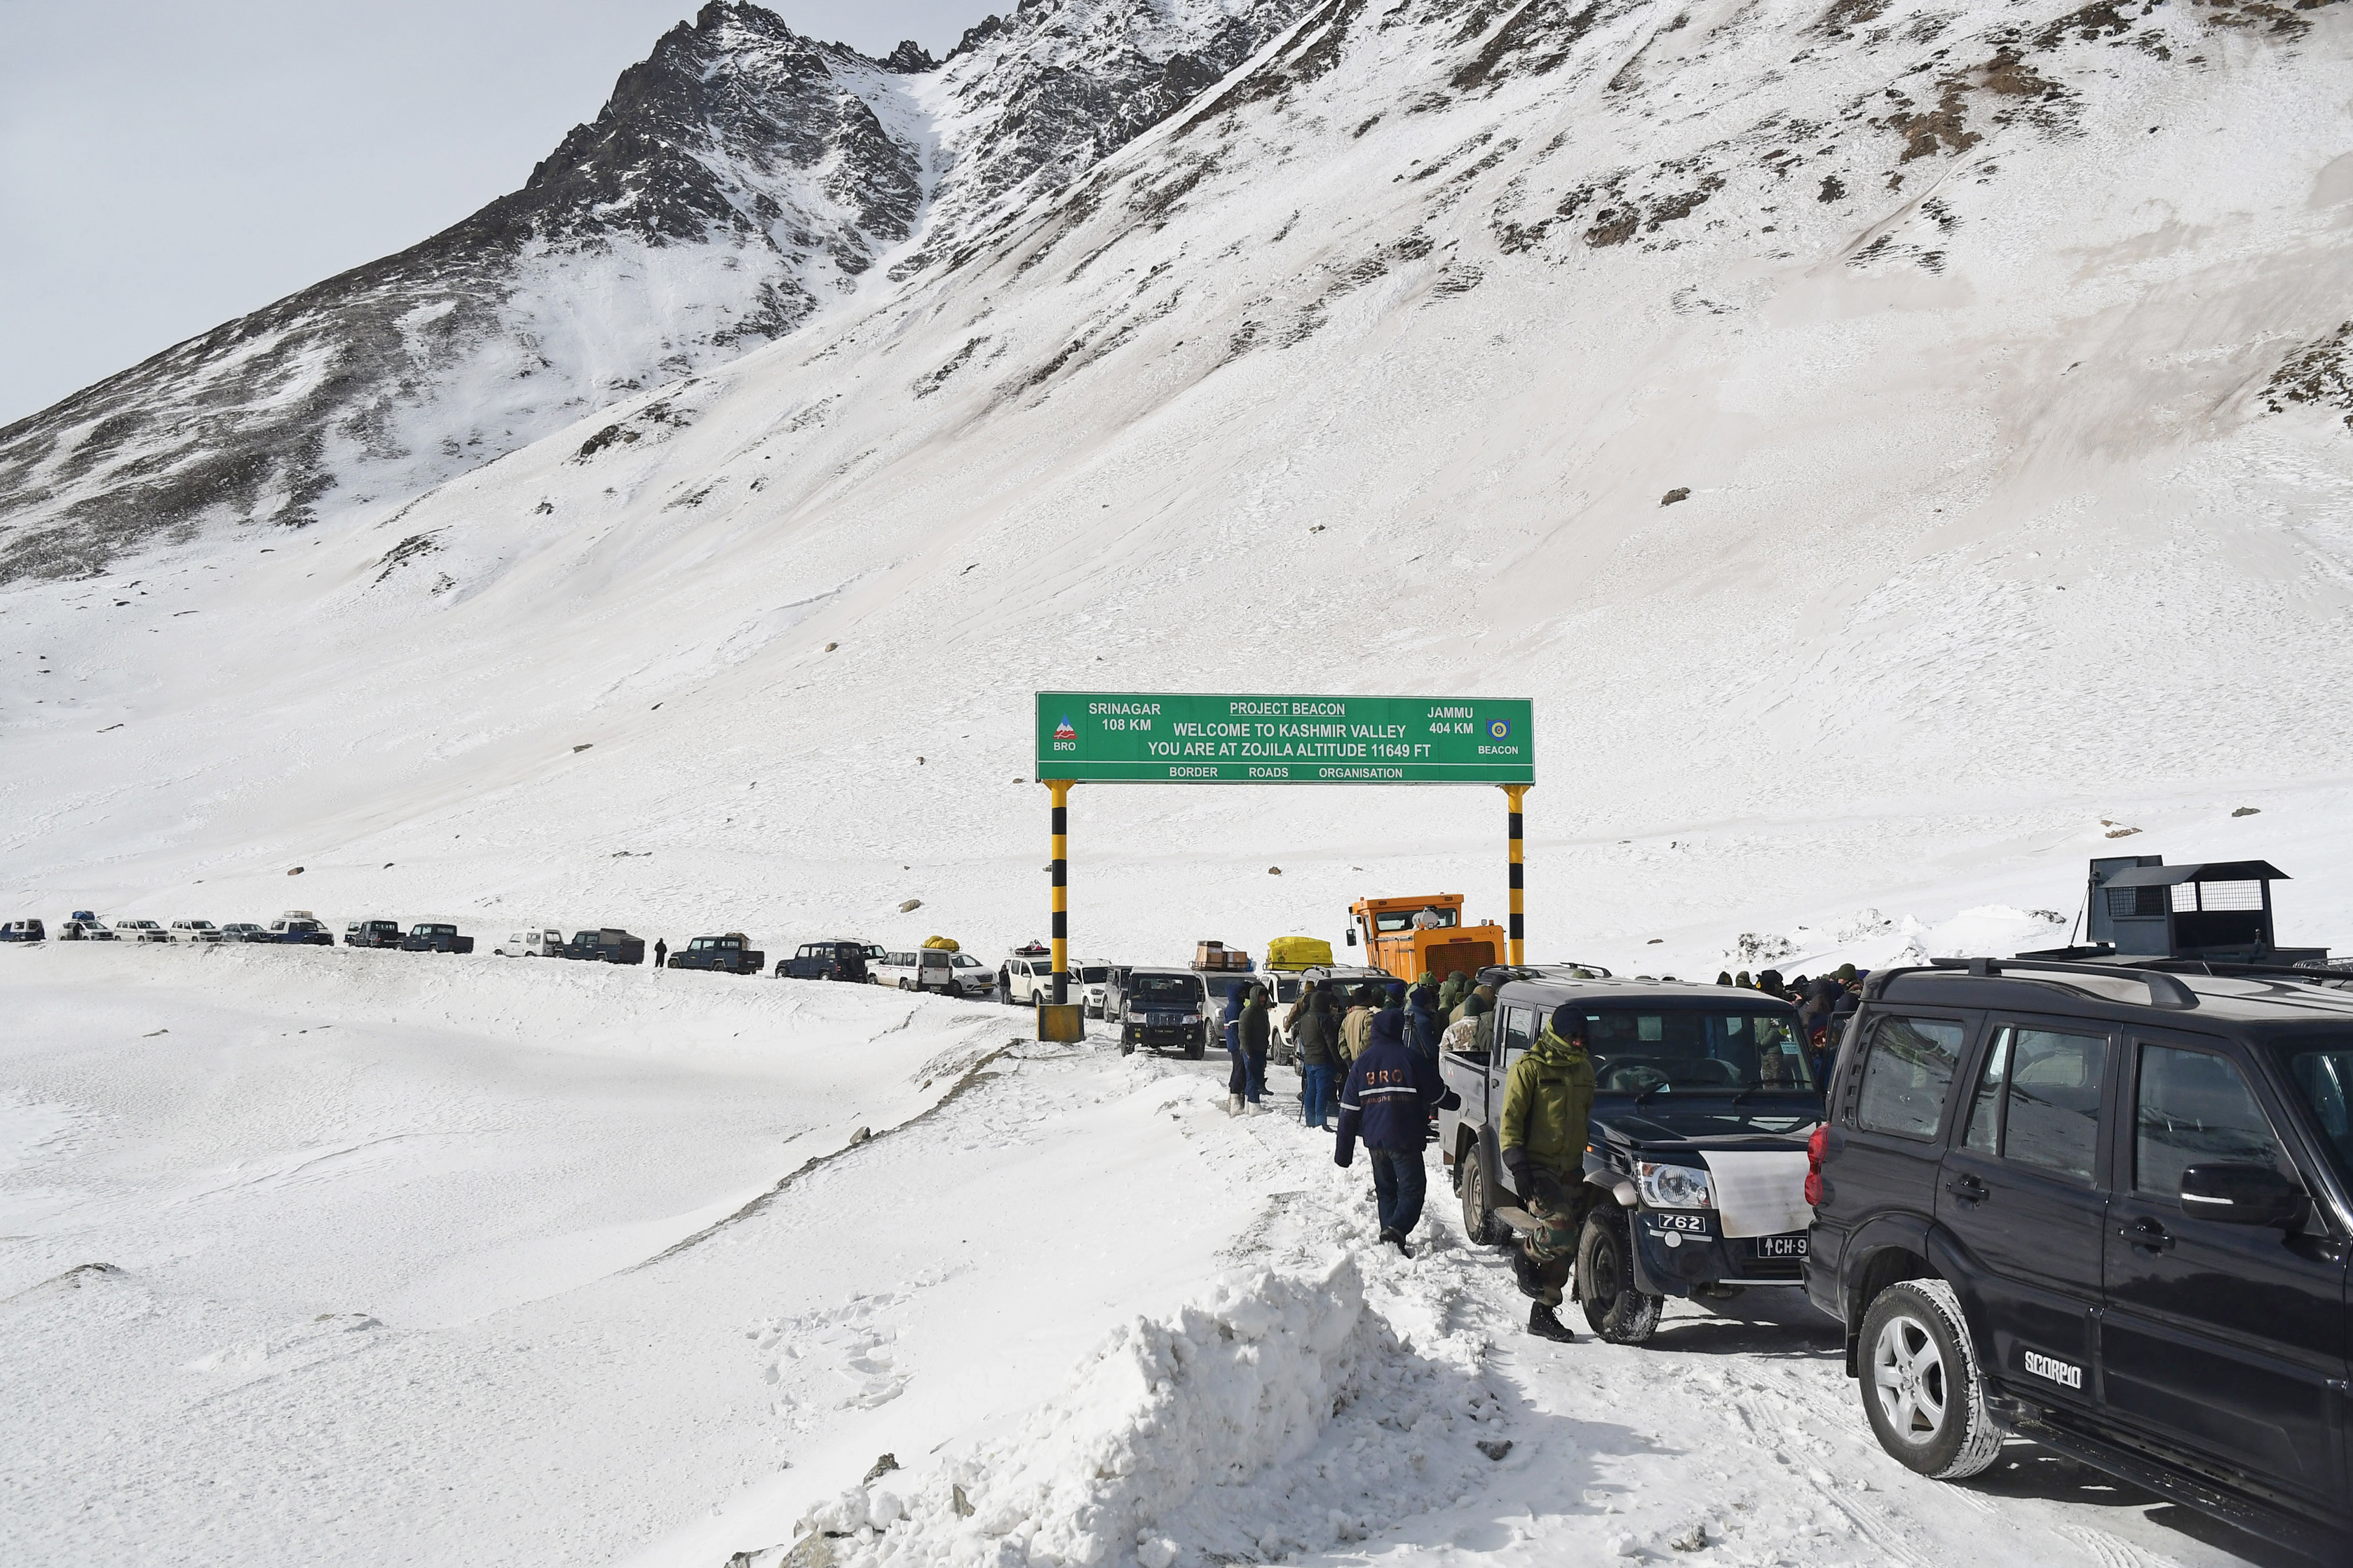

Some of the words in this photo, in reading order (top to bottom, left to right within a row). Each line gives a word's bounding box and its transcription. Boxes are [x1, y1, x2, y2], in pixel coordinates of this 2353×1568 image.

[1089, 702, 1161, 715] SRINAGAR
[1230, 702, 1289, 714] PROJECT
[1292, 703, 1345, 715] BEACON
[1427, 707, 1473, 718] JAMMU
[1102, 718, 1125, 730] 108
[1130, 718, 1151, 730] KM
[1173, 723, 1250, 737] WELCOME
[1254, 723, 1275, 737] TO
[1279, 723, 1347, 737] KASHMIR
[1350, 725, 1406, 738] VALLEY
[1429, 723, 1451, 734] 404
[1454, 723, 1474, 734] KM
[1053, 742, 1076, 751] BRO
[1148, 742, 1180, 756] YOU
[1184, 742, 1215, 756] ARE
[1219, 742, 1237, 756] AT
[1241, 743, 1294, 756] ZOJILA
[1296, 743, 1367, 757] ALTITUDE
[1371, 744, 1410, 757] 11649
[1414, 744, 1431, 757] FT
[1478, 745, 1519, 754] BEACON
[1169, 767, 1218, 777] BORDER
[1249, 768, 1289, 777] ROADS
[1319, 768, 1403, 778] ORGANISATION
[1366, 1069, 1403, 1085] BRO
[1663, 1215, 1700, 1230] 762
[2024, 1350, 2082, 1389] SCORPIO
